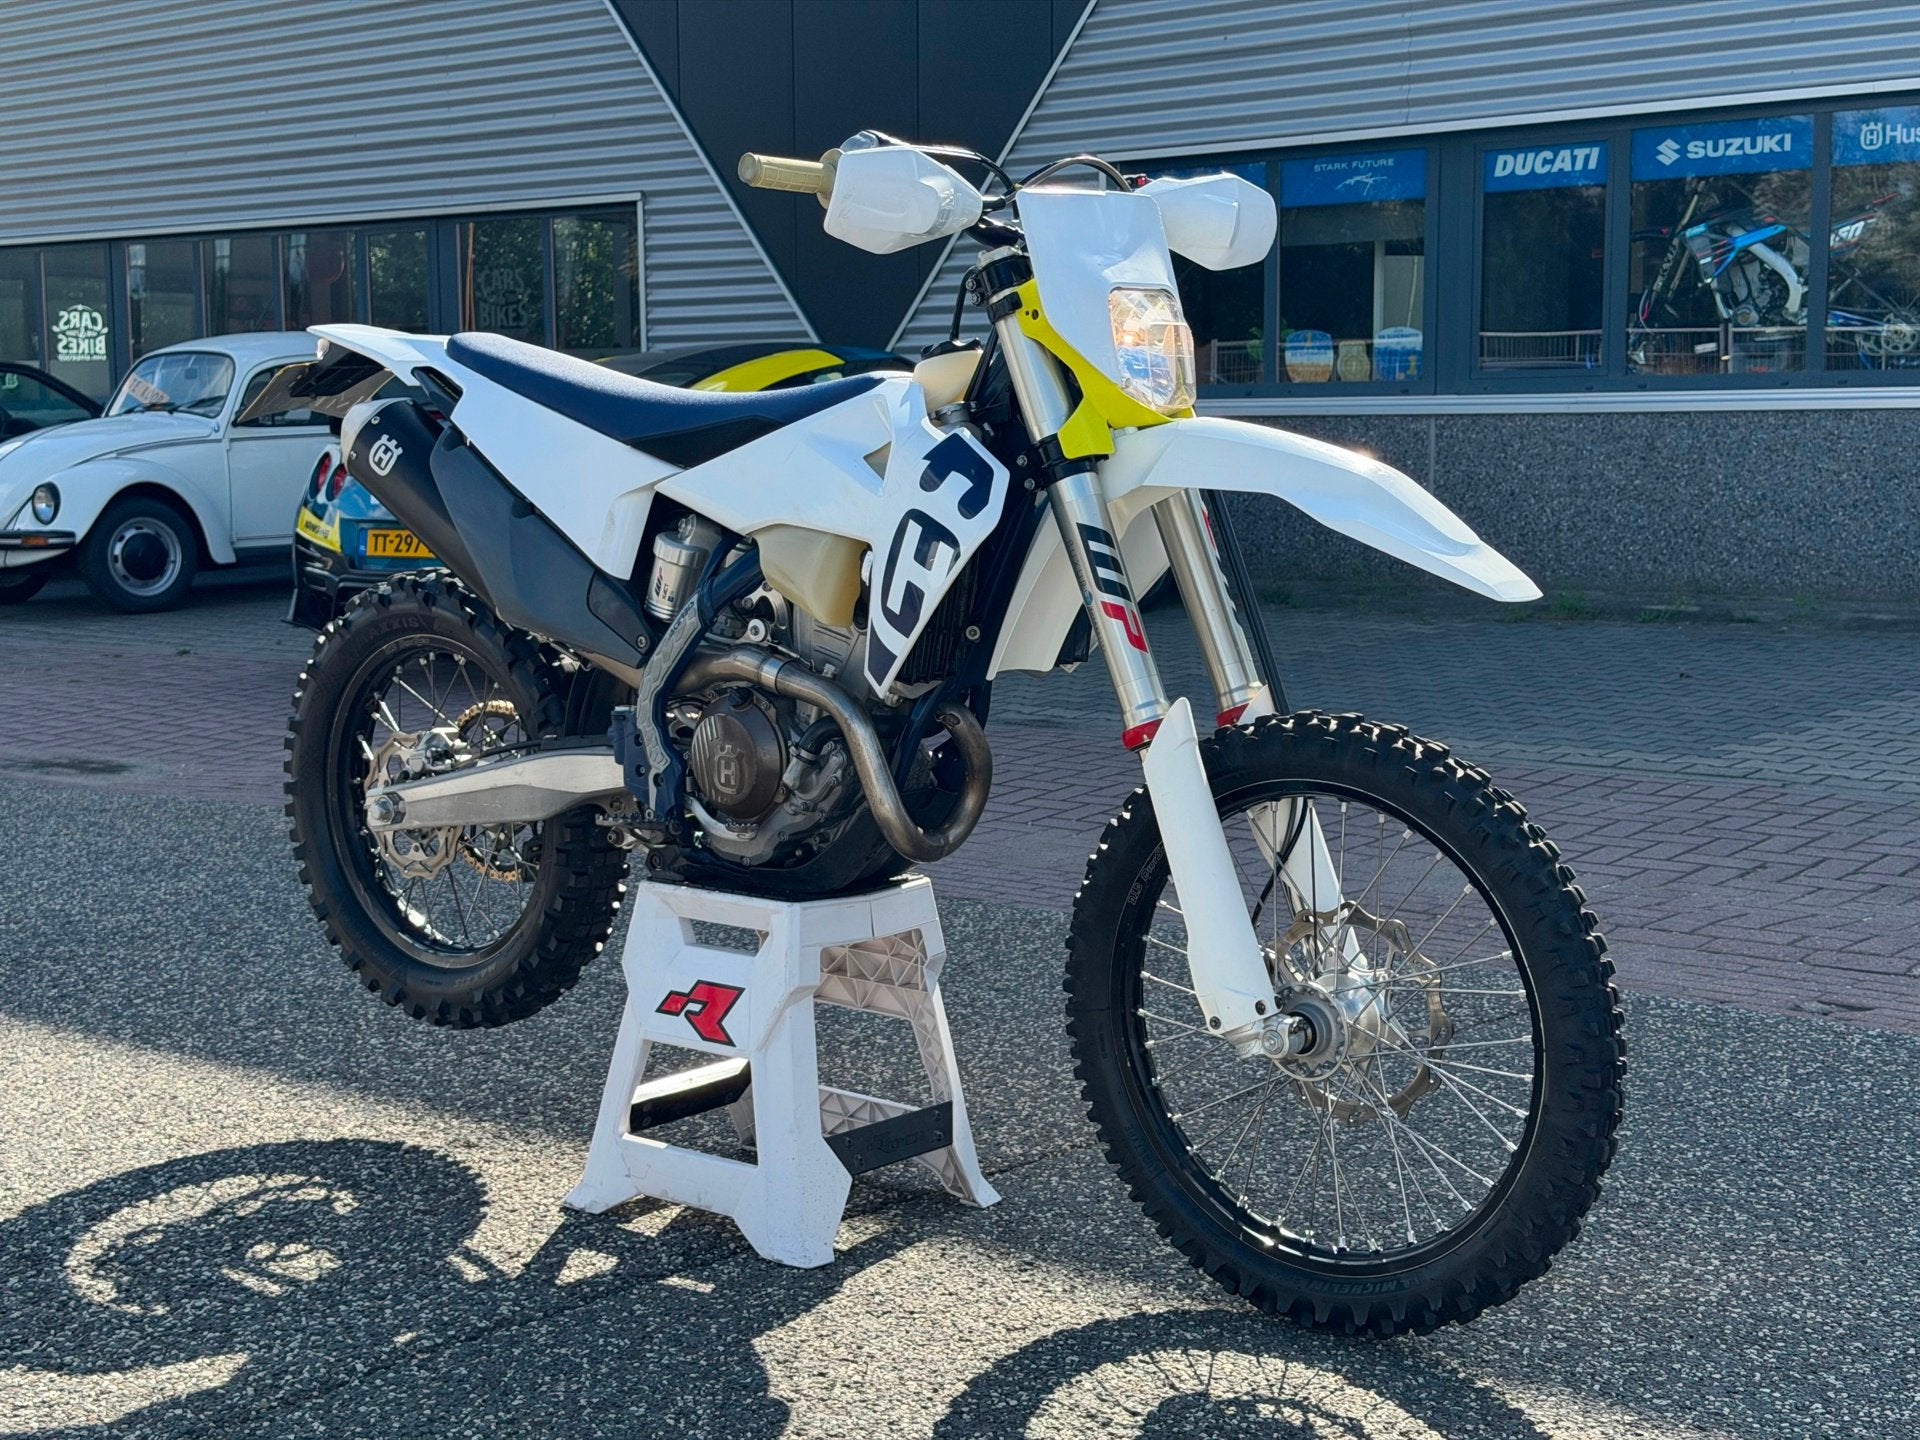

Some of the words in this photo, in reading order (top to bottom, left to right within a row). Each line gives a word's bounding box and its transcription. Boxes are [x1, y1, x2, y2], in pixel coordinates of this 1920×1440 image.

[1686, 133, 1792, 159] SUZUKI
[1314, 162, 1348, 173] STARK
[1352, 157, 1395, 168] FUTURE
[1494, 147, 1600, 178] DUCATI
[480, 301, 528, 328] BIKES
[373, 533, 433, 553] TT-297
[1304, 1276, 1399, 1294] MICHELIN
